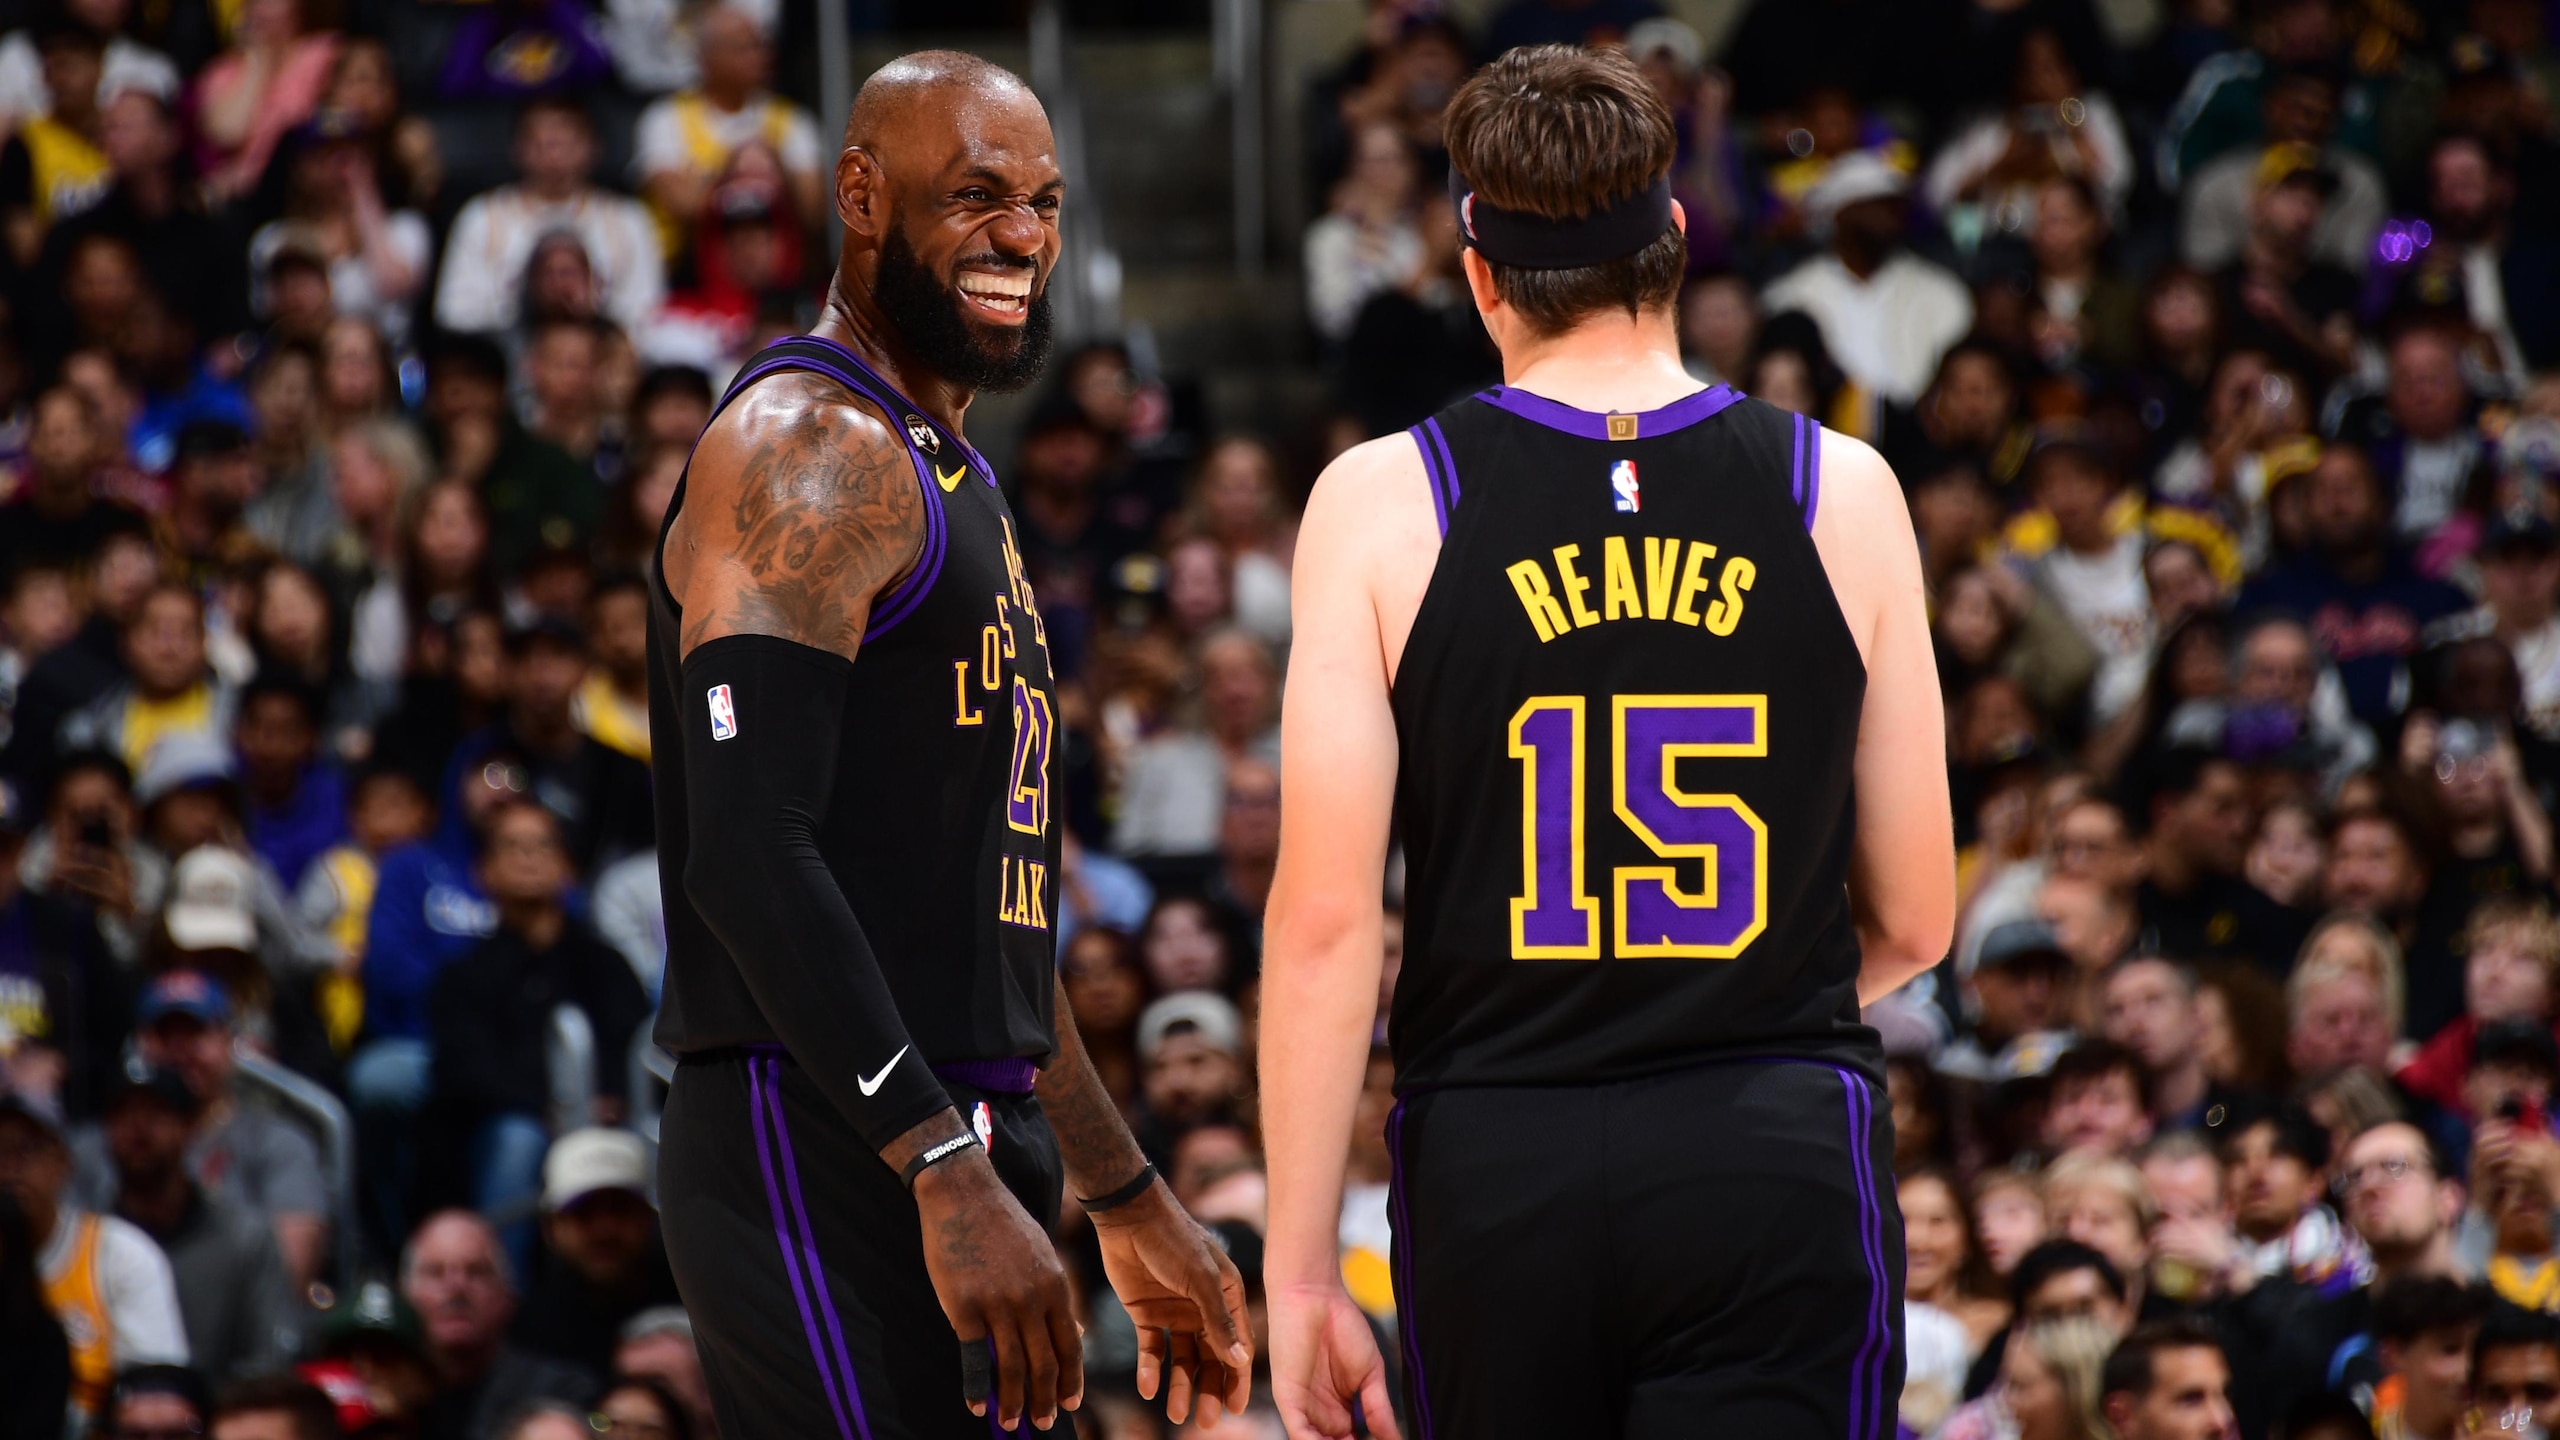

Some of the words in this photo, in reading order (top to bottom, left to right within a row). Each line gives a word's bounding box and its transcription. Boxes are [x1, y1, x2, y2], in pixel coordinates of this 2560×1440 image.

[1505, 535, 1756, 643] REAVES
[954, 594, 1016, 726] LOS
[1007, 672, 1054, 838] 23
[1508, 694, 1768, 960] 15
[922, 1135, 970, 1163] PROMISE
